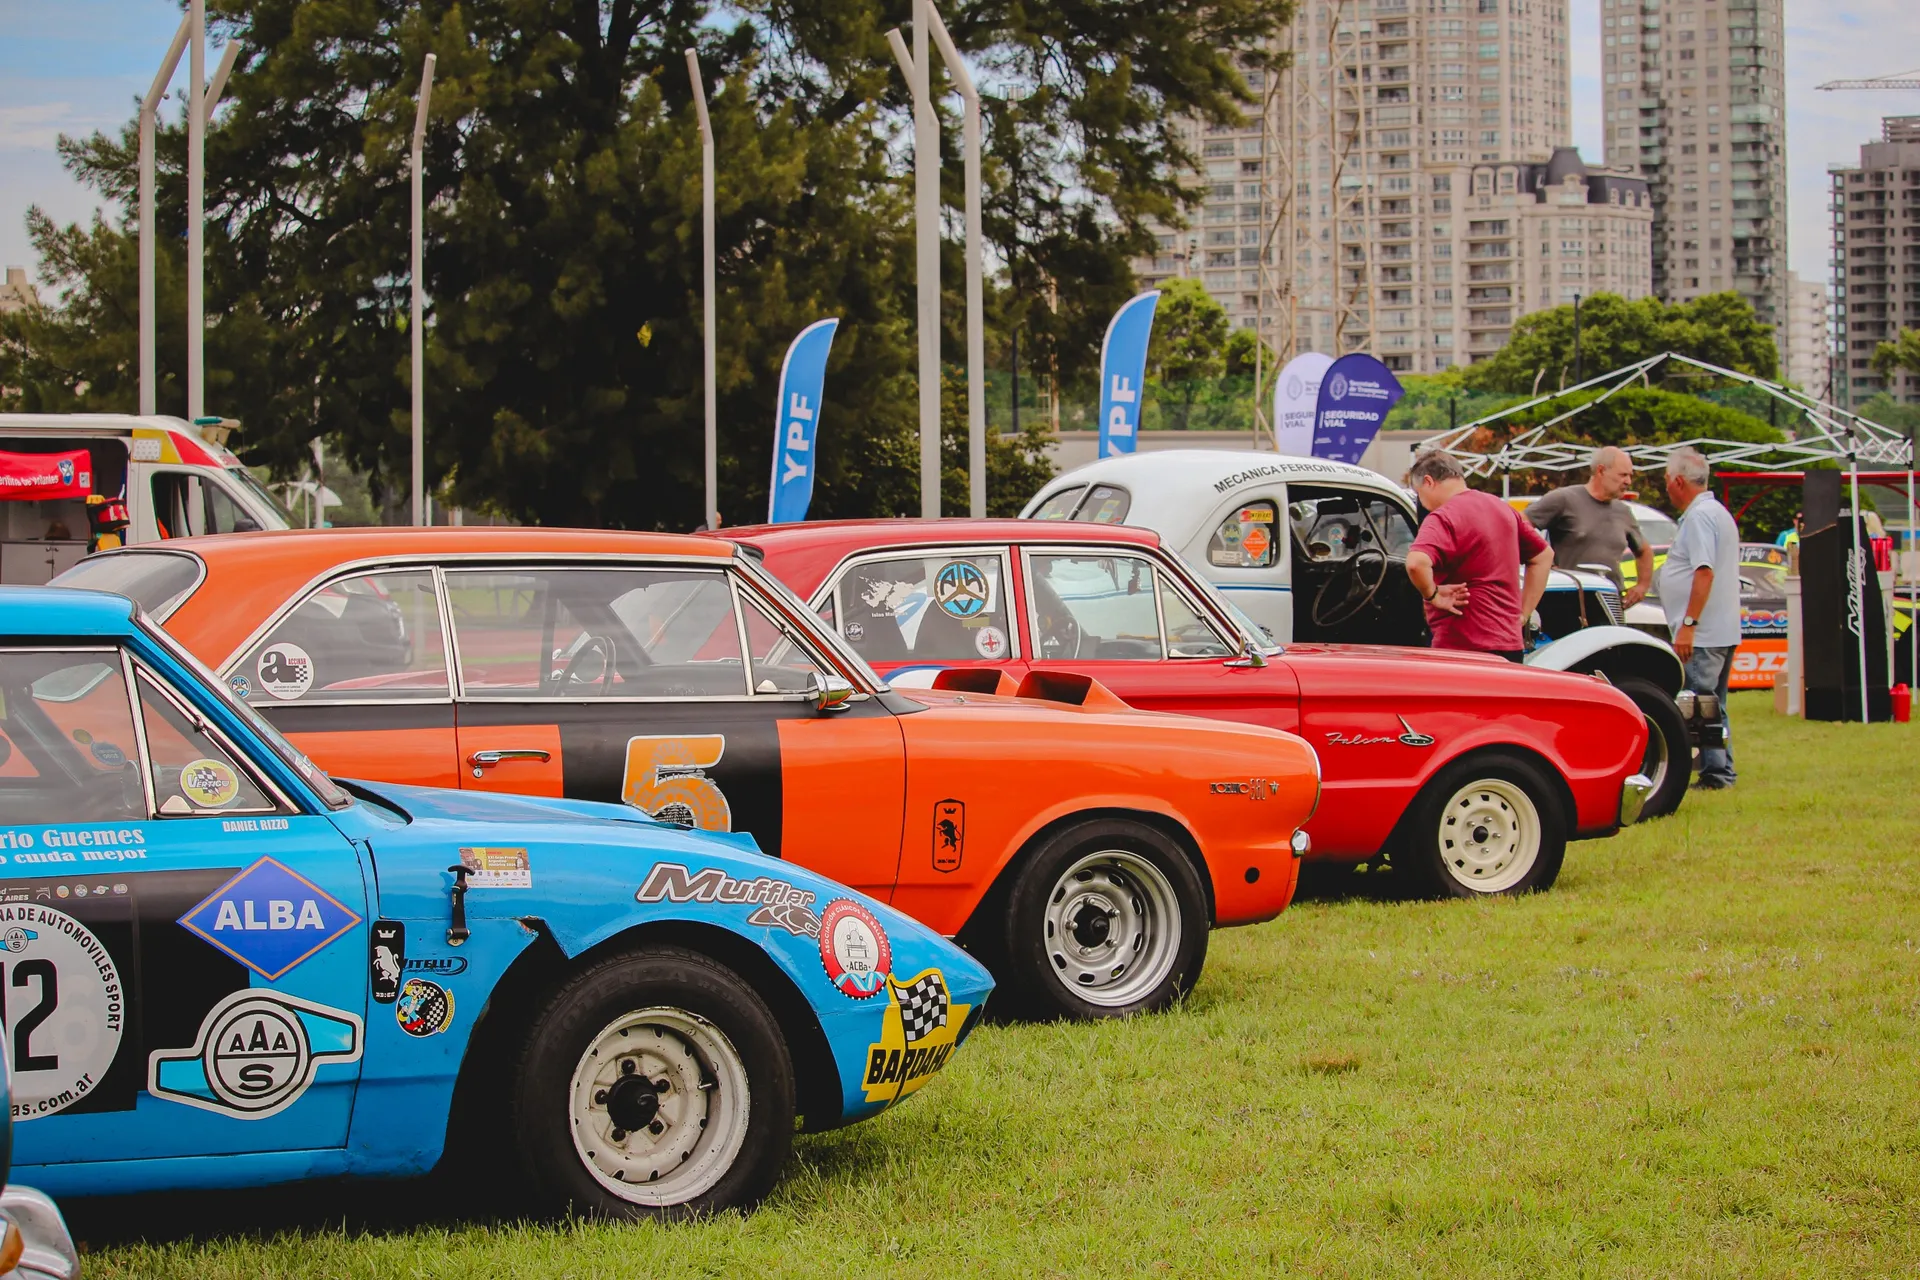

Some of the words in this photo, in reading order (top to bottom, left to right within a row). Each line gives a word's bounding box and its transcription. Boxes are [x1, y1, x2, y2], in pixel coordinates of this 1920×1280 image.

[1284, 420, 1306, 428] VIAL
[1323, 410, 1379, 421] SEGURIDAD
[1323, 420, 1346, 428] VIAL
[782, 392, 813, 486] YPF
[1213, 465, 1281, 494] MECANICA
[1280, 463, 1336, 474] FERRONI
[1324, 732, 1396, 746] Falcon
[621, 734, 731, 832] 5
[42, 829, 145, 847] Guemes
[222, 820, 259, 832] DANIEL
[260, 819, 289, 831] RIZZO
[81, 849, 147, 861] mejor
[636, 862, 816, 907] Muffler
[214, 900, 325, 930] ALBA
[861, 912, 869, 920] DE
[869, 921, 888, 957] BALLESTER
[18, 908, 35, 921] DE
[38, 910, 114, 982] AUTOMOVILES
[105, 984, 121, 1031] SPORT
[229, 1020, 288, 1052] AAA
[238, 1063, 275, 1092] S
